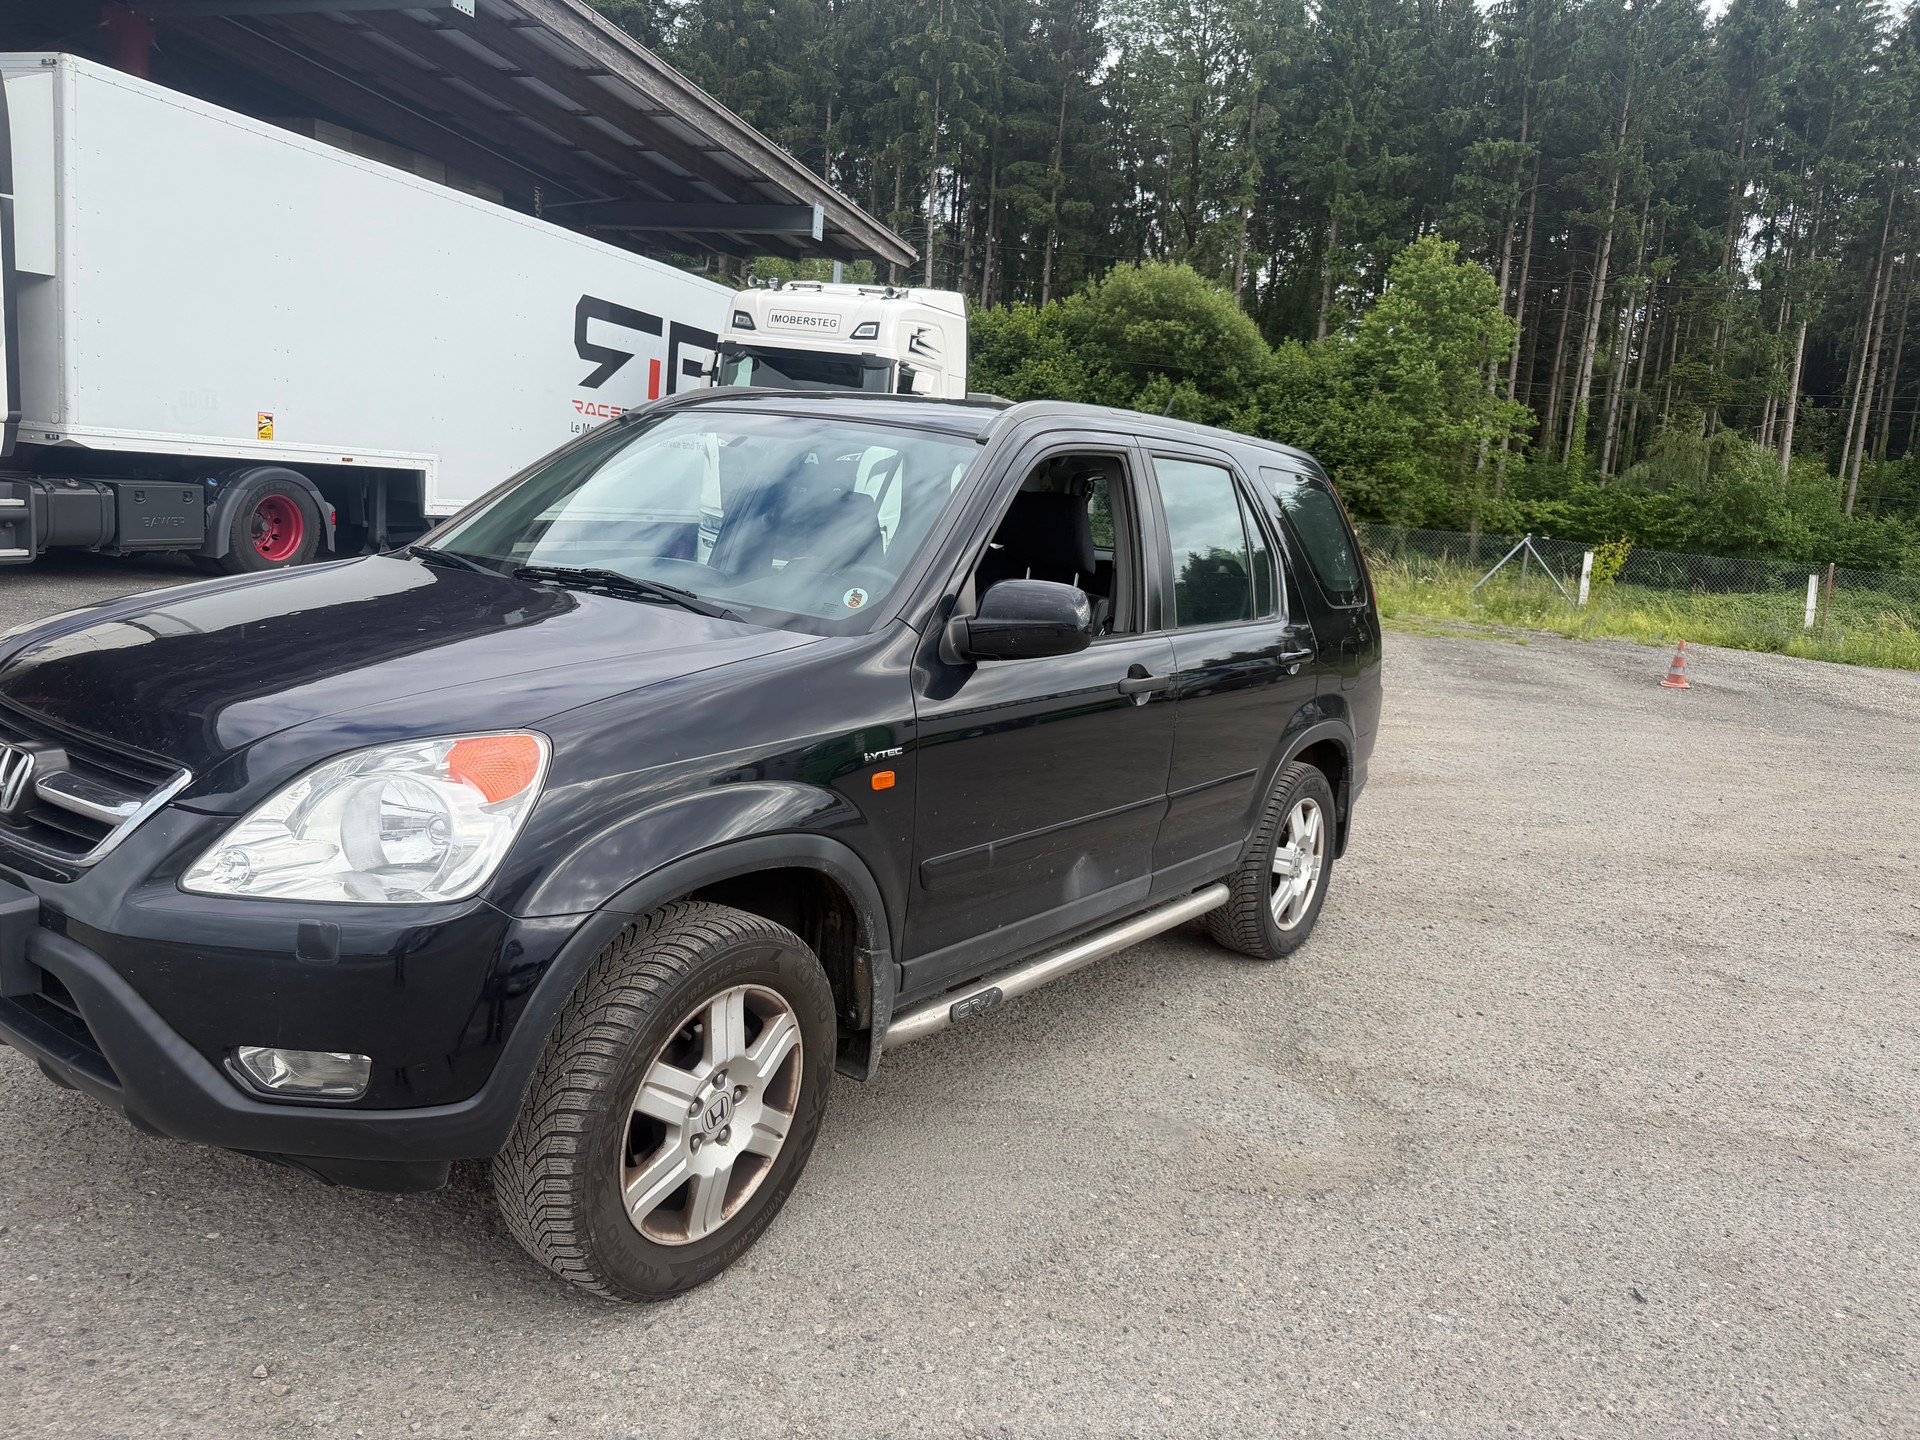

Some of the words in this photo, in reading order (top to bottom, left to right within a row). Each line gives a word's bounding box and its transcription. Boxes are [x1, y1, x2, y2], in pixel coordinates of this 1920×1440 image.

[771, 314, 837, 328] IMOBERSTEG
[570, 420, 581, 434] Le
[708, 964, 732, 986] R16
[735, 956, 759, 971] 99H
